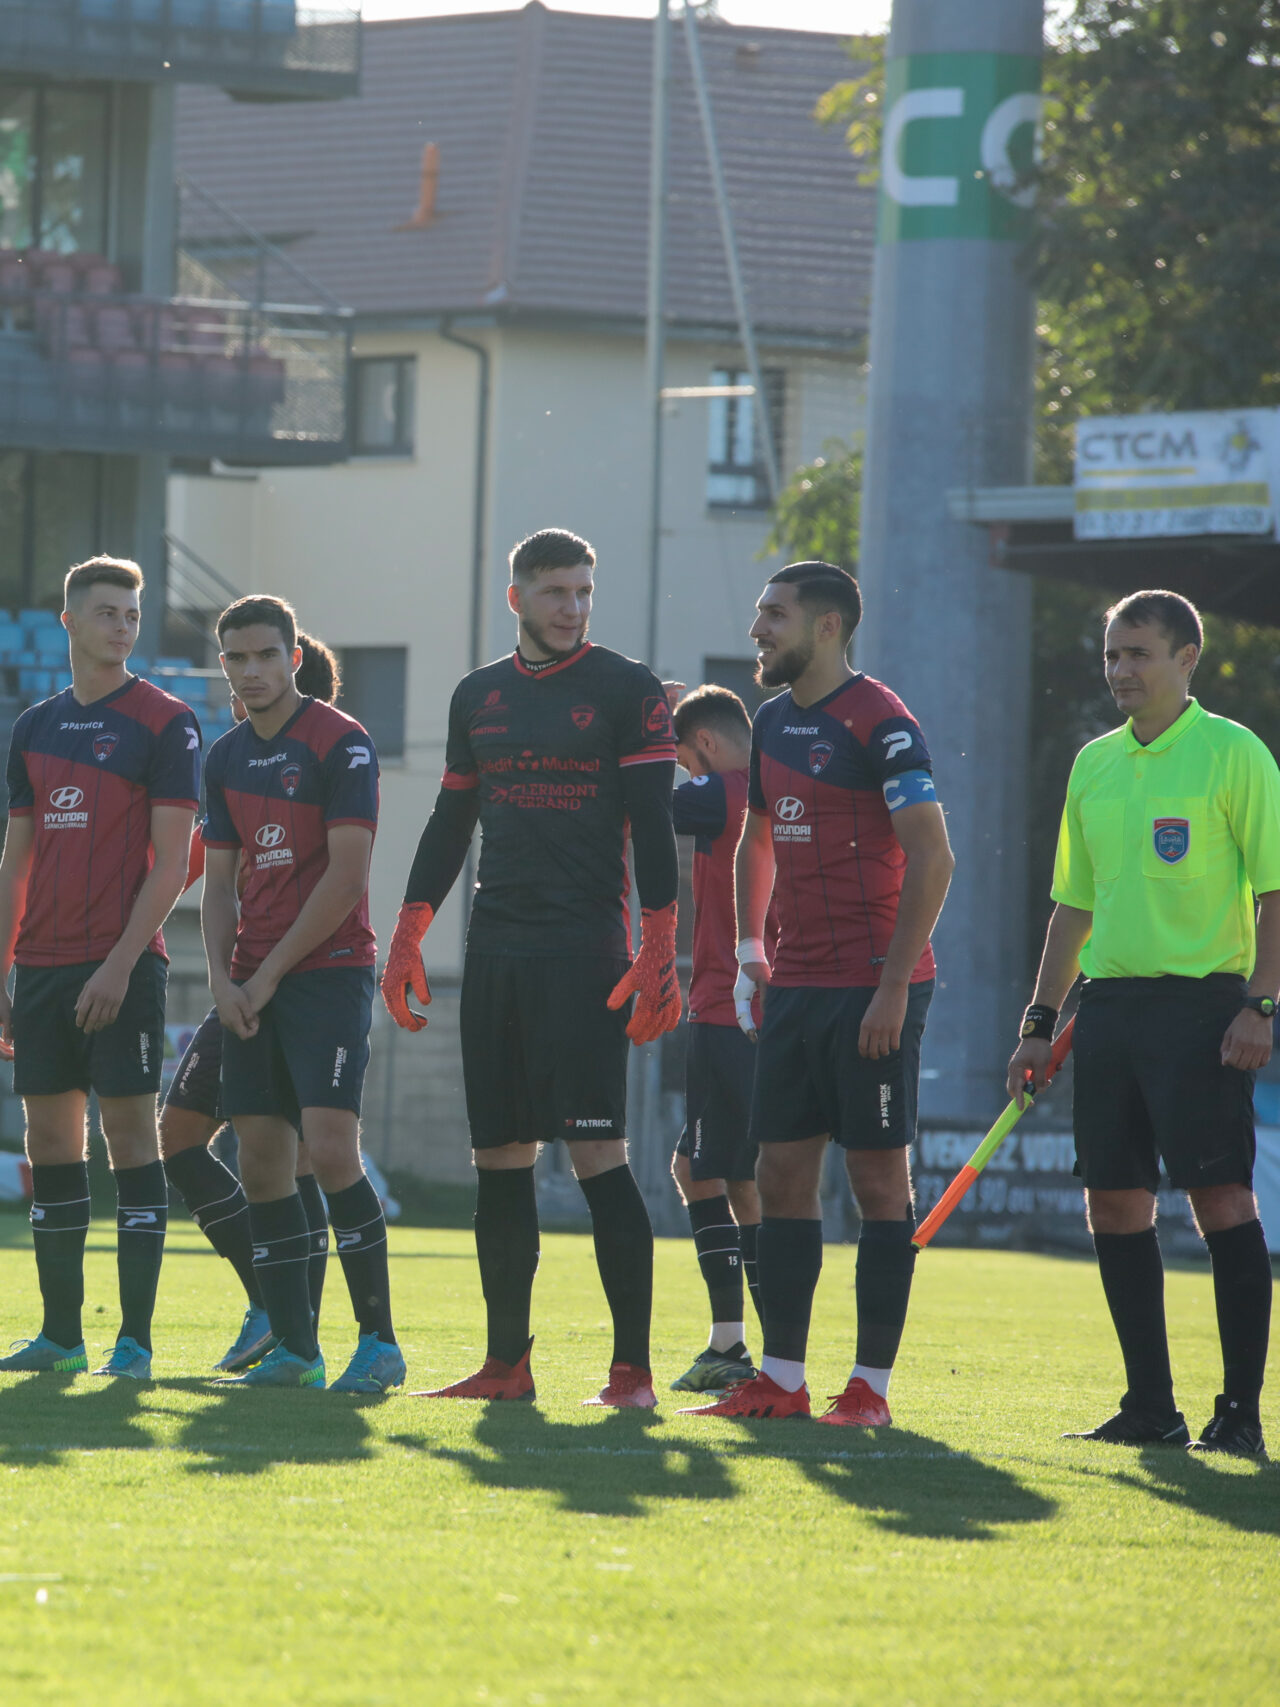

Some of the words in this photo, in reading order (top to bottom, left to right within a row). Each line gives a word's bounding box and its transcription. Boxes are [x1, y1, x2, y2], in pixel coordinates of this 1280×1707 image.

[1082, 428, 1198, 462] CTCM
[68, 721, 104, 730] PATRICK
[790, 726, 820, 735] PATRICK
[542, 756, 600, 772] Mutuel
[511, 783, 598, 797] CLERMONT
[510, 796, 581, 810] FERRAND
[44, 812, 88, 822] HYUNDAI
[774, 825, 811, 835] HYUNDAI
[256, 848, 293, 863] HYUNDAI
[334, 1046, 344, 1077] PATRICK
[880, 1084, 889, 1117] PATRICK
[576, 1119, 612, 1128] PATRICK
[921, 1131, 1019, 1171] VENEZ
[728, 1255, 738, 1266] 15
